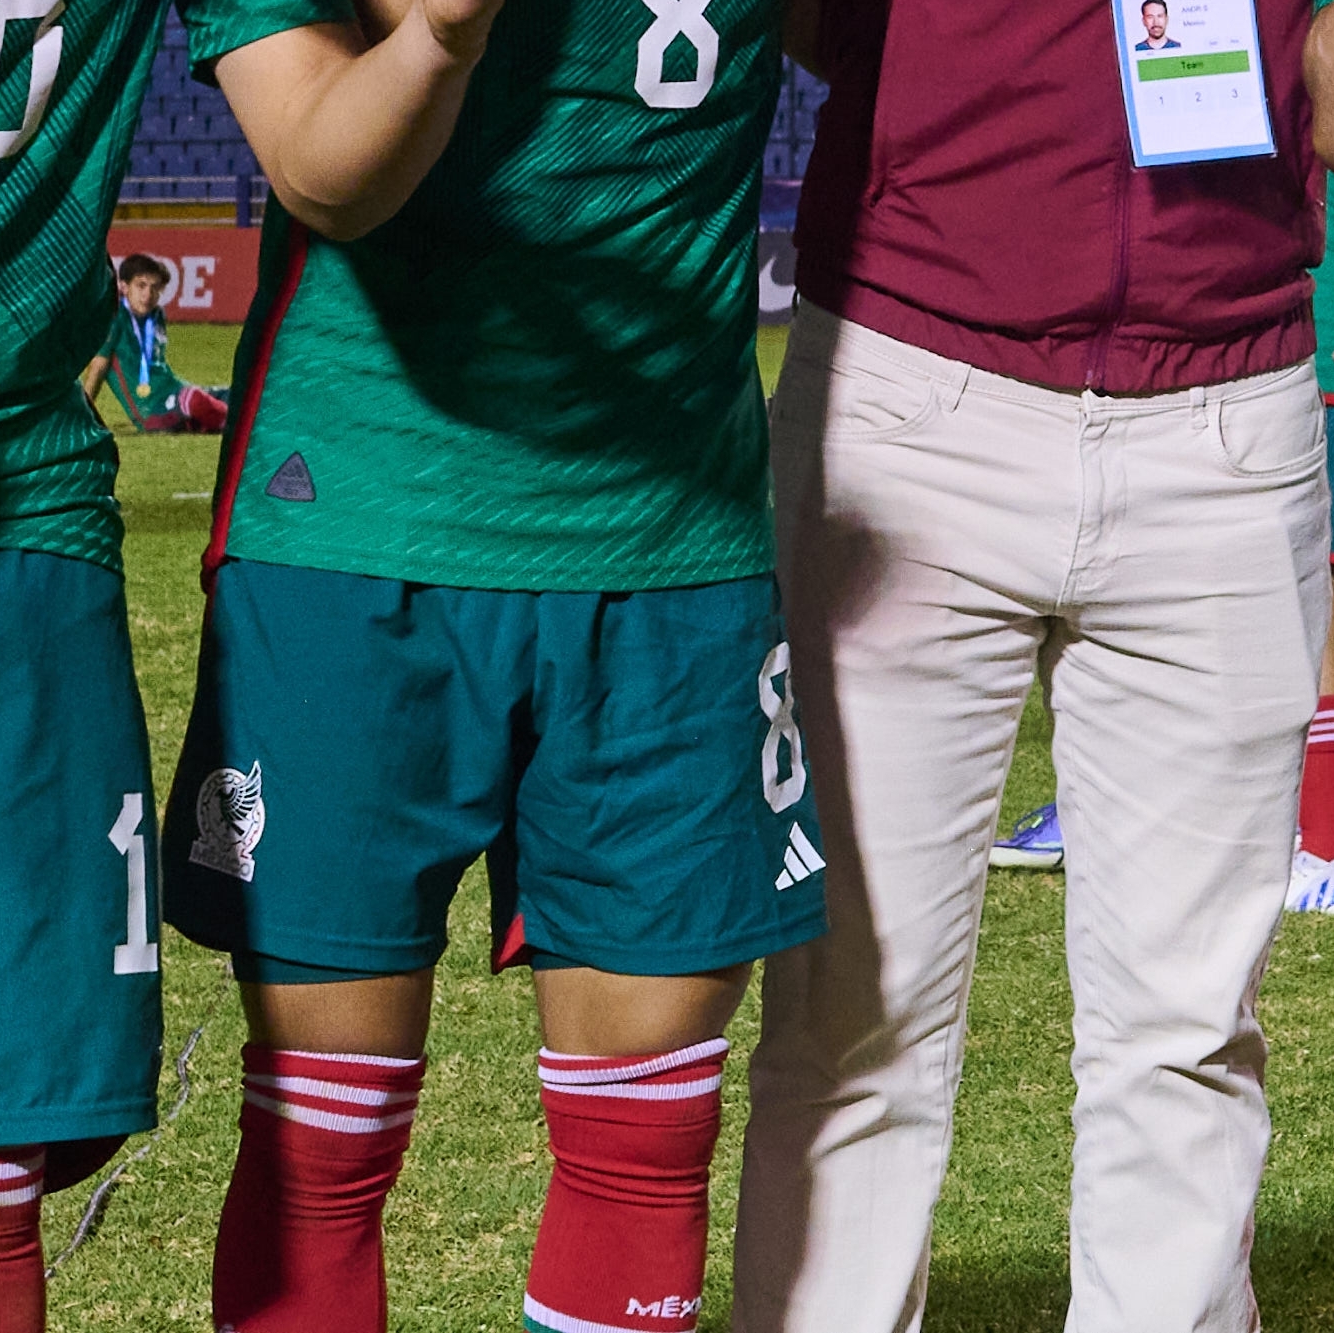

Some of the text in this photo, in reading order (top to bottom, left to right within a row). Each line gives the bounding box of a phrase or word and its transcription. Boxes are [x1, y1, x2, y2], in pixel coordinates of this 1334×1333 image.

[1195, 91, 1203, 102] 2
[1231, 88, 1239, 99] 3
[758, 642, 807, 814] 8
[108, 793, 160, 975] 1
